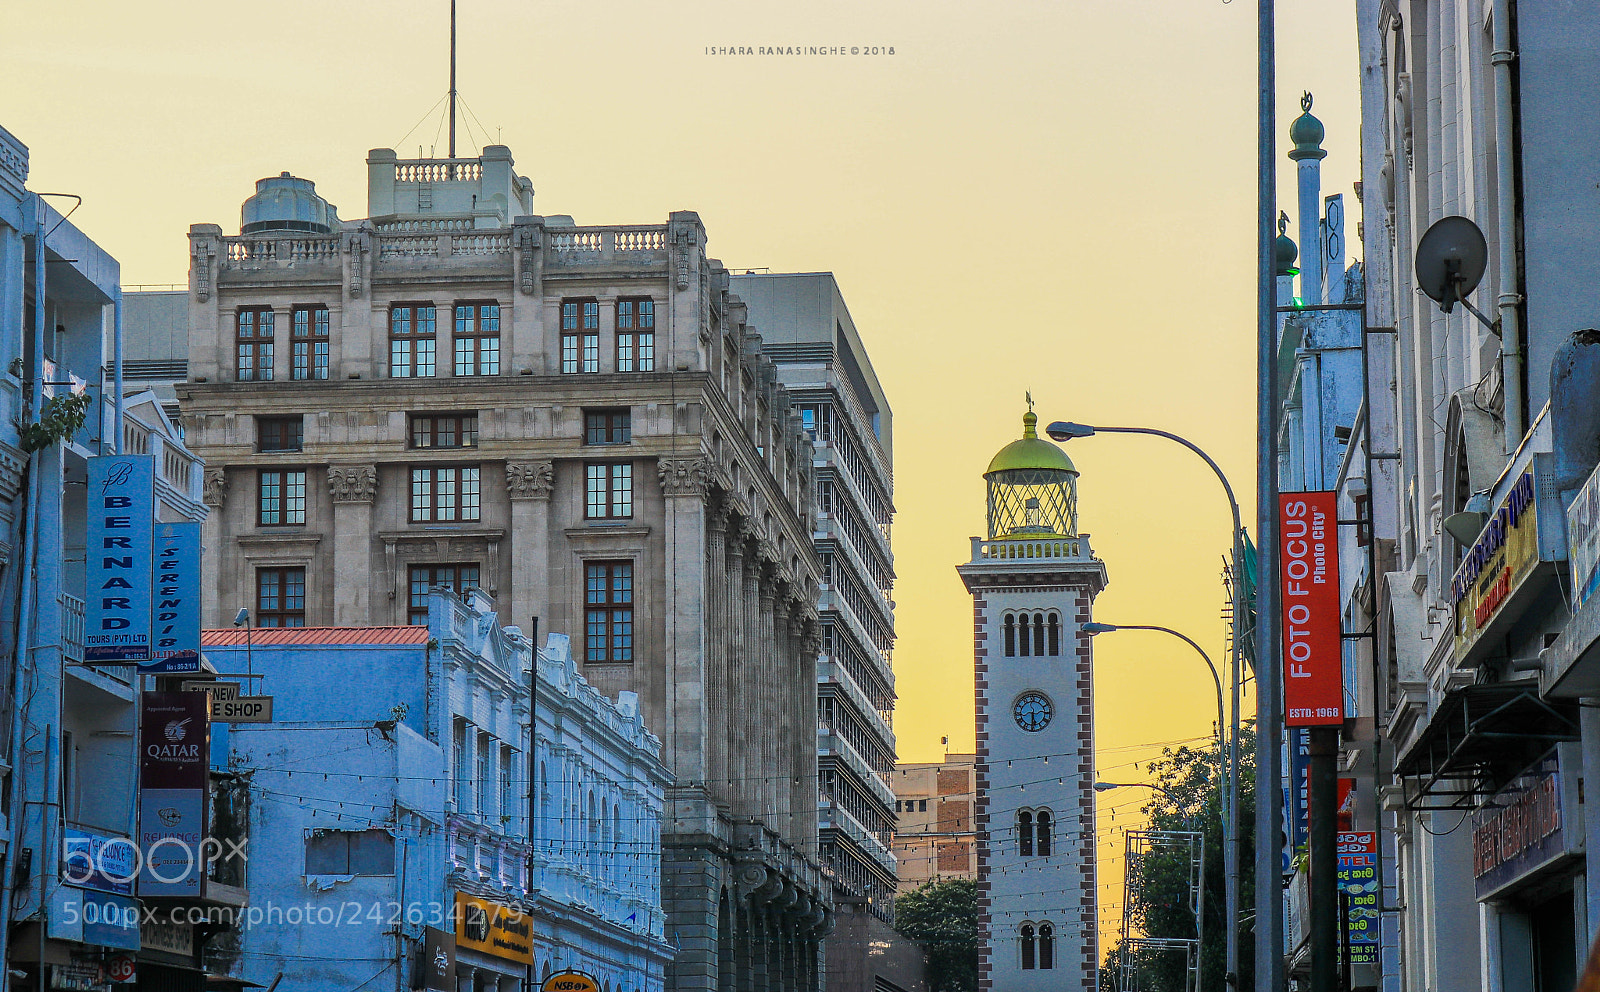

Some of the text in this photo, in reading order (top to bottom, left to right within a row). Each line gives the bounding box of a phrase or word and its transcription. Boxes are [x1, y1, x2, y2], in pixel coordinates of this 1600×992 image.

[101, 496, 133, 630] BERNARD
[1313, 543, 1326, 584] Photo
[1286, 501, 1311, 678] FOTO FOCUS
[159, 548, 182, 647] SERENDIB
[87, 634, 147, 645] TOURS (PVT) LTD
[152, 648, 198, 659] LIDAYS
[212, 687, 235, 701] NEW
[224, 703, 263, 717] SHOP
[1289, 707, 1339, 718] ESTD: 1968
[147, 744, 199, 759] QATAR
[143, 833, 199, 843] RELIANCE
[1337, 856, 1374, 866] TEL
[110, 959, 132, 976] 86
[554, 981, 574, 991] NSB
